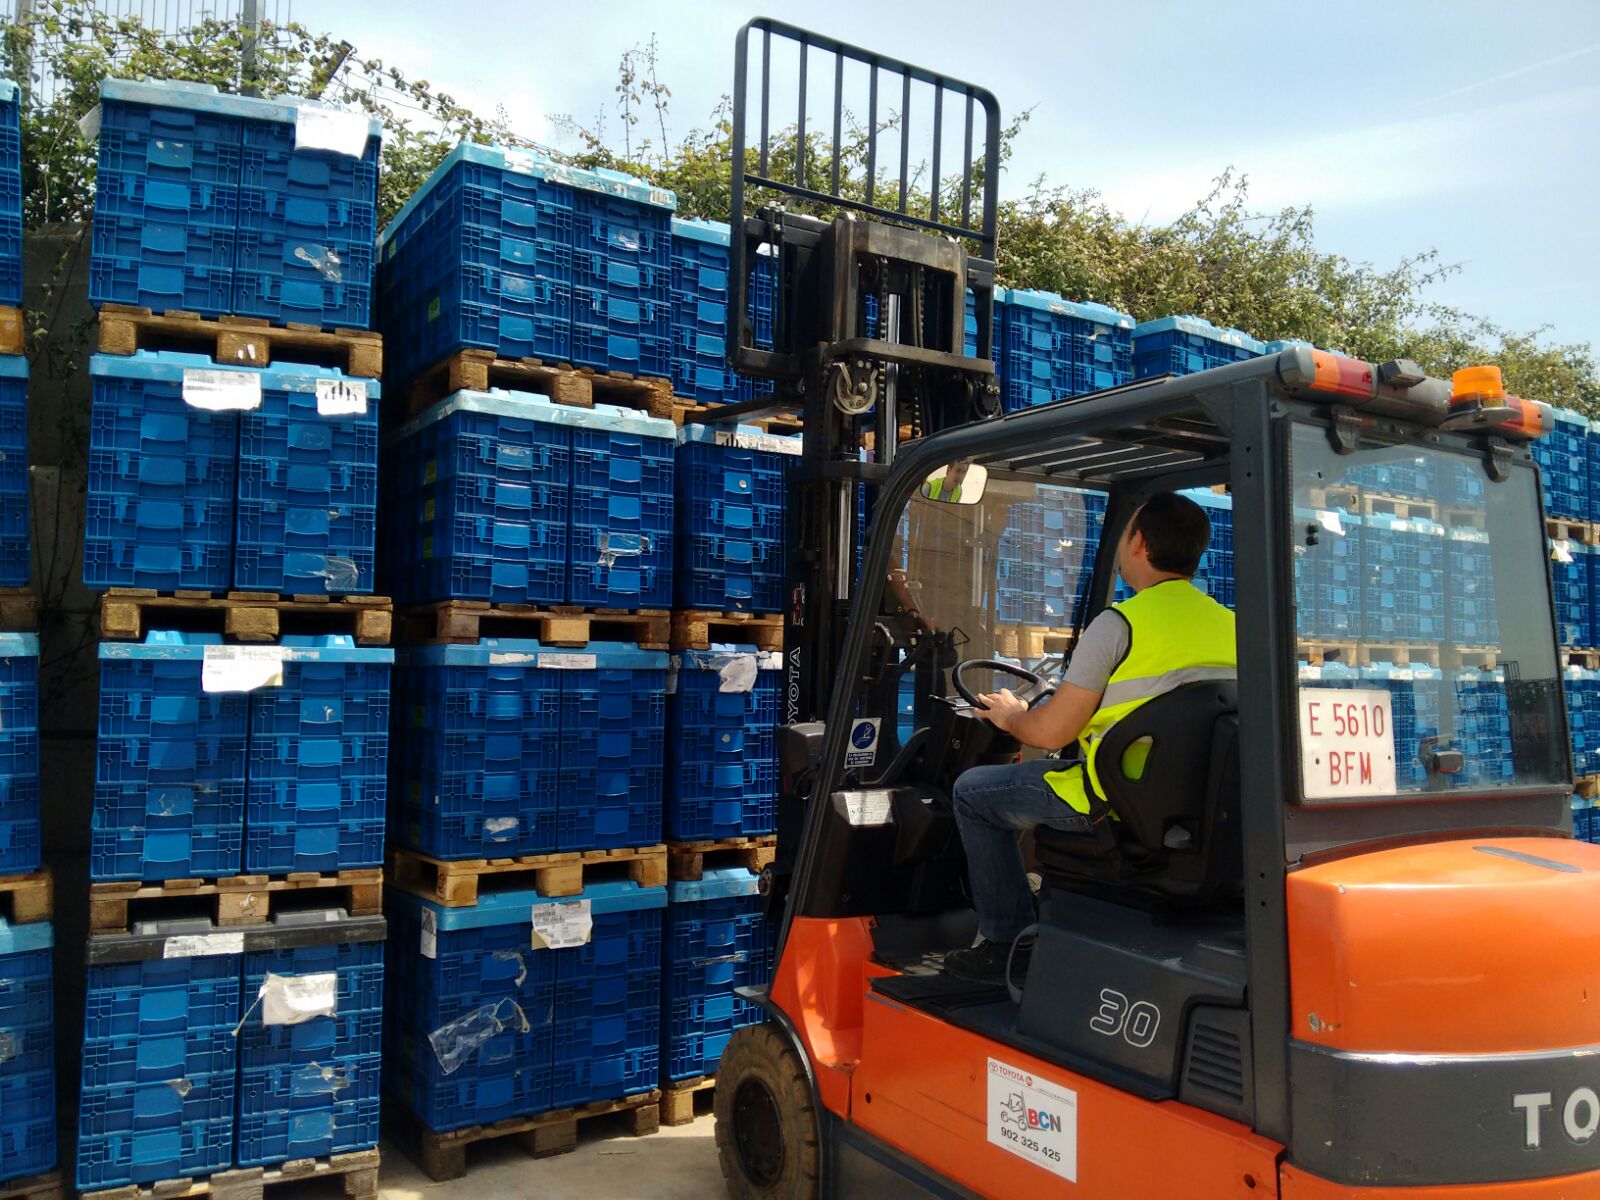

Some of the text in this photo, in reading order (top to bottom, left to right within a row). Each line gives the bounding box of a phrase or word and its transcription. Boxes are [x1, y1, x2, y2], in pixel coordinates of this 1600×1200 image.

[1308, 702, 1384, 737] E 5610
[1329, 751, 1372, 785] BFM
[1089, 988, 1161, 1048] 30
[999, 1064, 1025, 1082] TOYOTA
[1027, 1108, 1062, 1133] BCN
[1512, 1087, 1600, 1147] TO
[1001, 1126, 1019, 1143] 902
[1020, 1135, 1039, 1152] 325
[1041, 1146, 1061, 1162] 425
